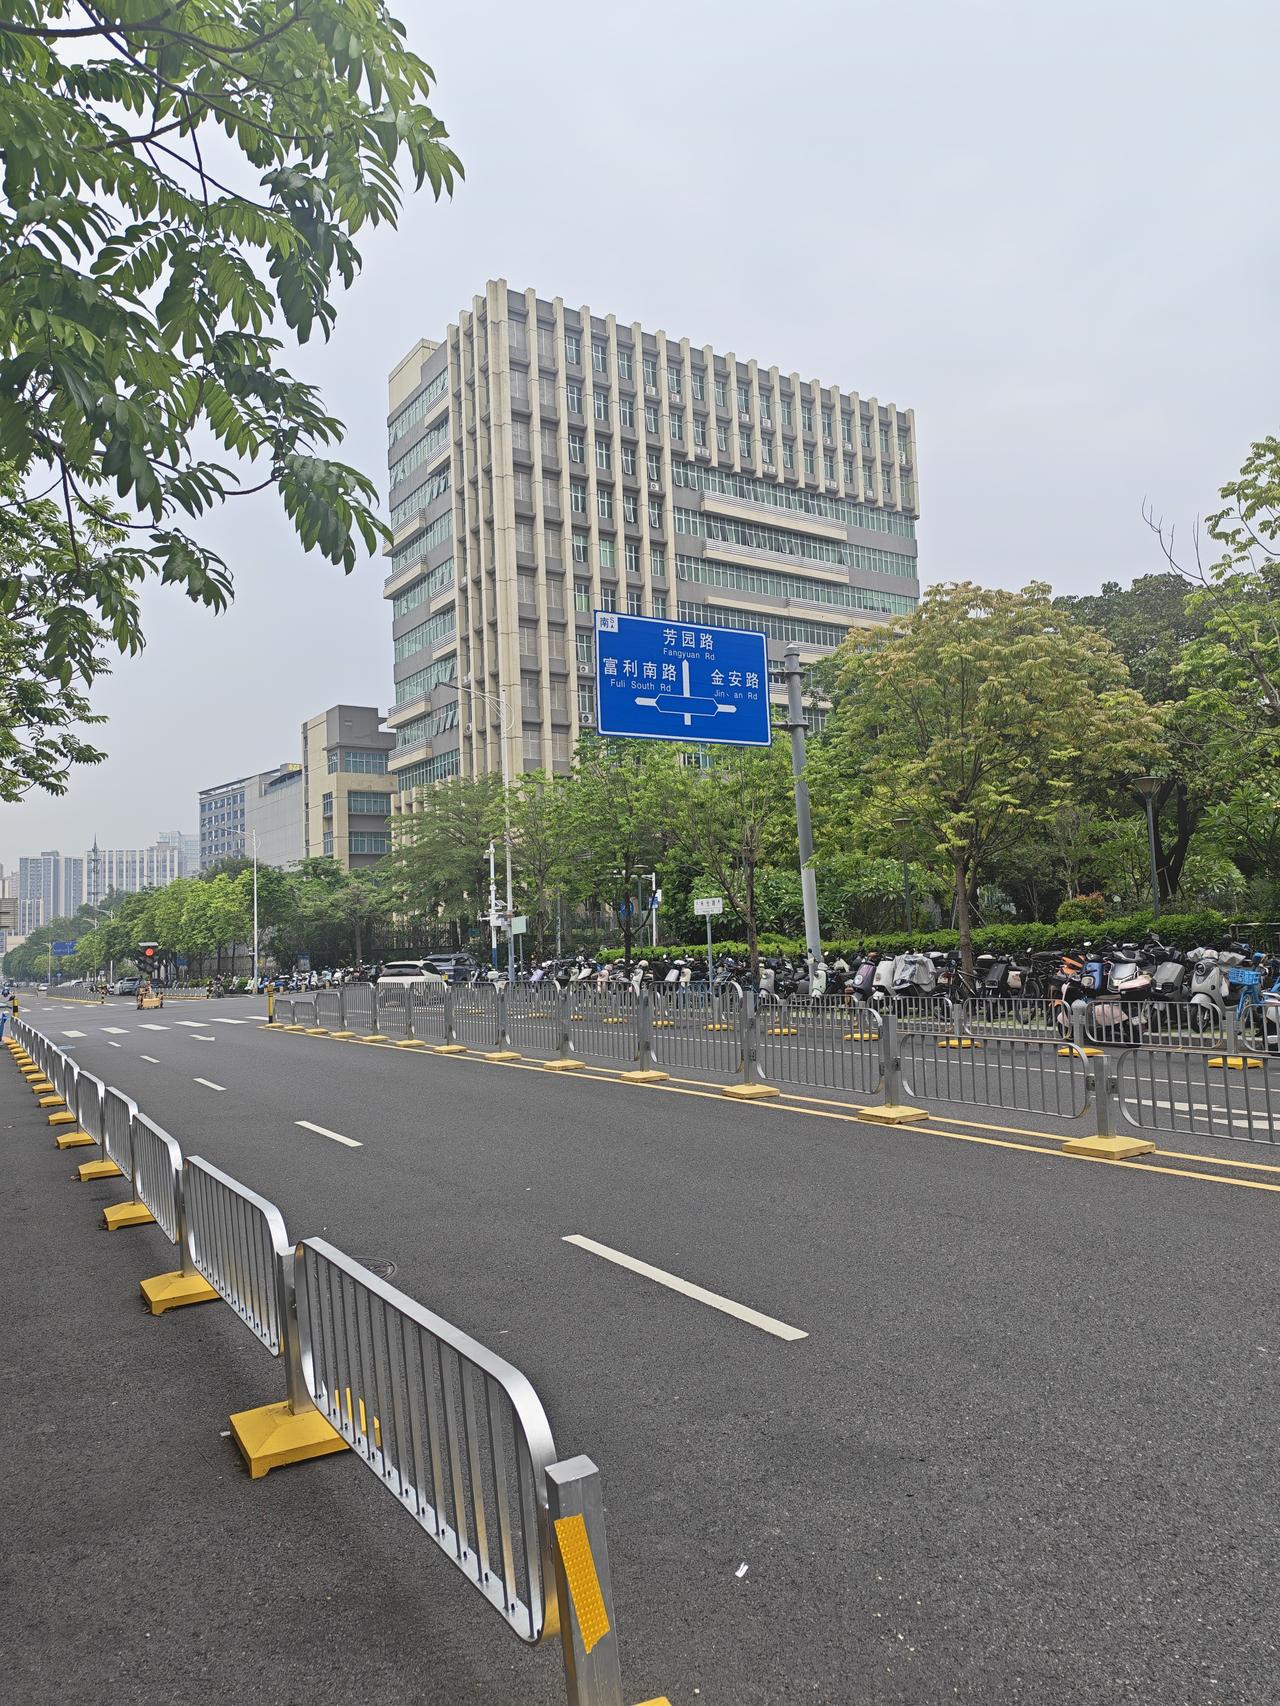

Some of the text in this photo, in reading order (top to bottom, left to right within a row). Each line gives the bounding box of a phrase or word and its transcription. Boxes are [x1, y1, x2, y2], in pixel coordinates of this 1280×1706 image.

[600, 617, 609, 628] 南
[663, 628, 714, 650] 芳园路
[663, 648, 715, 661] Fangyuan Rd
[603, 657, 677, 682] 富利南路
[610, 678, 672, 692] Fuli South Rd
[710, 669, 759, 689] 金安路
[747, 692, 758, 700] Rd
